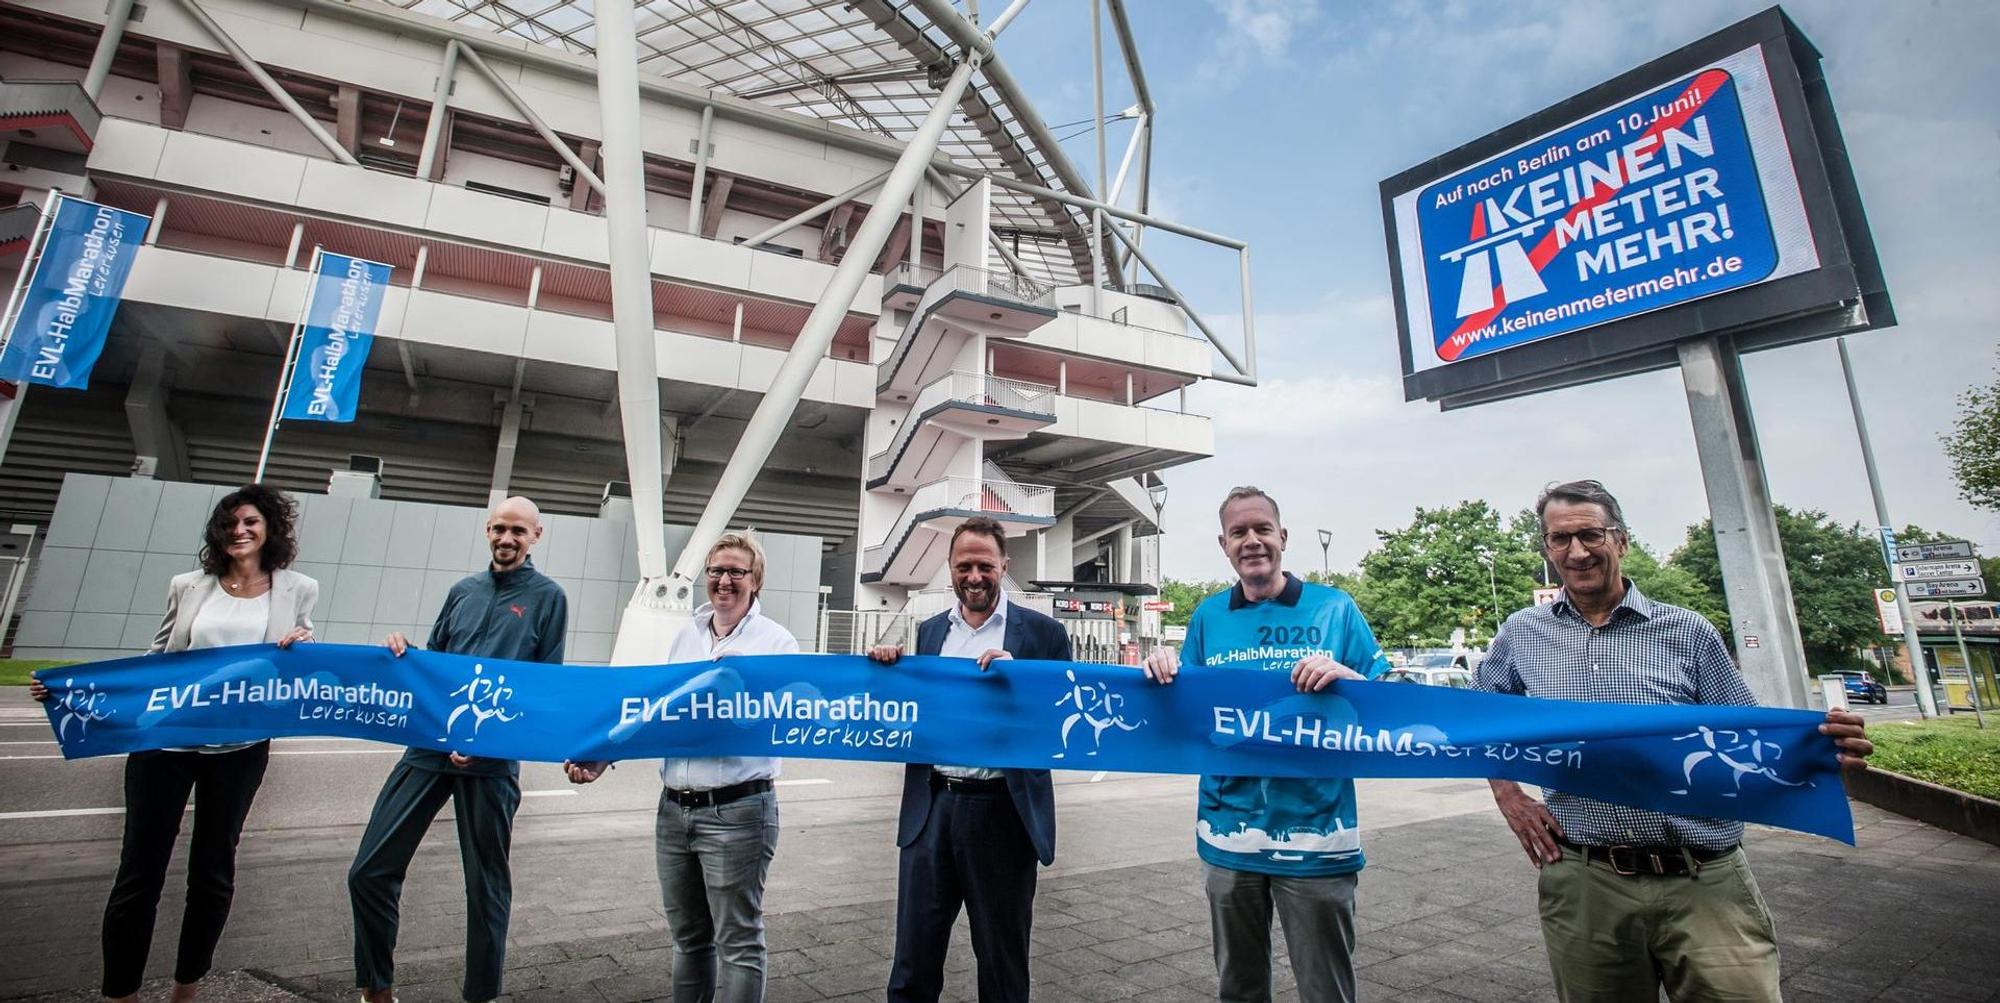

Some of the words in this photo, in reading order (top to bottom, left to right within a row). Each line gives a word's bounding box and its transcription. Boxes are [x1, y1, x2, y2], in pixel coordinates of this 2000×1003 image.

[1435, 185, 1463, 209] Auf
[1467, 168, 1513, 195] nach
[1518, 144, 1571, 174] Berlin
[1576, 128, 1611, 150] am
[1485, 116, 1715, 234] KEINEN
[1552, 169, 1724, 249] METER
[1576, 204, 1735, 282] MEHR!
[32, 206, 115, 380] EVL-HalbMarathon
[89, 221, 126, 297] Leverkusen
[307, 258, 363, 416] EVL-HalbMarathon
[347, 271, 373, 340] Leverkusen
[1451, 254, 1743, 348] www.keinenmetermehr.de
[1258, 625, 1322, 646] 2020
[146, 677, 413, 712] EVL-HalbMarathon
[300, 704, 408, 729] Leverkusen
[620, 692, 919, 723] EVL-HalbMarathon
[771, 723, 914, 748] Leverkusen
